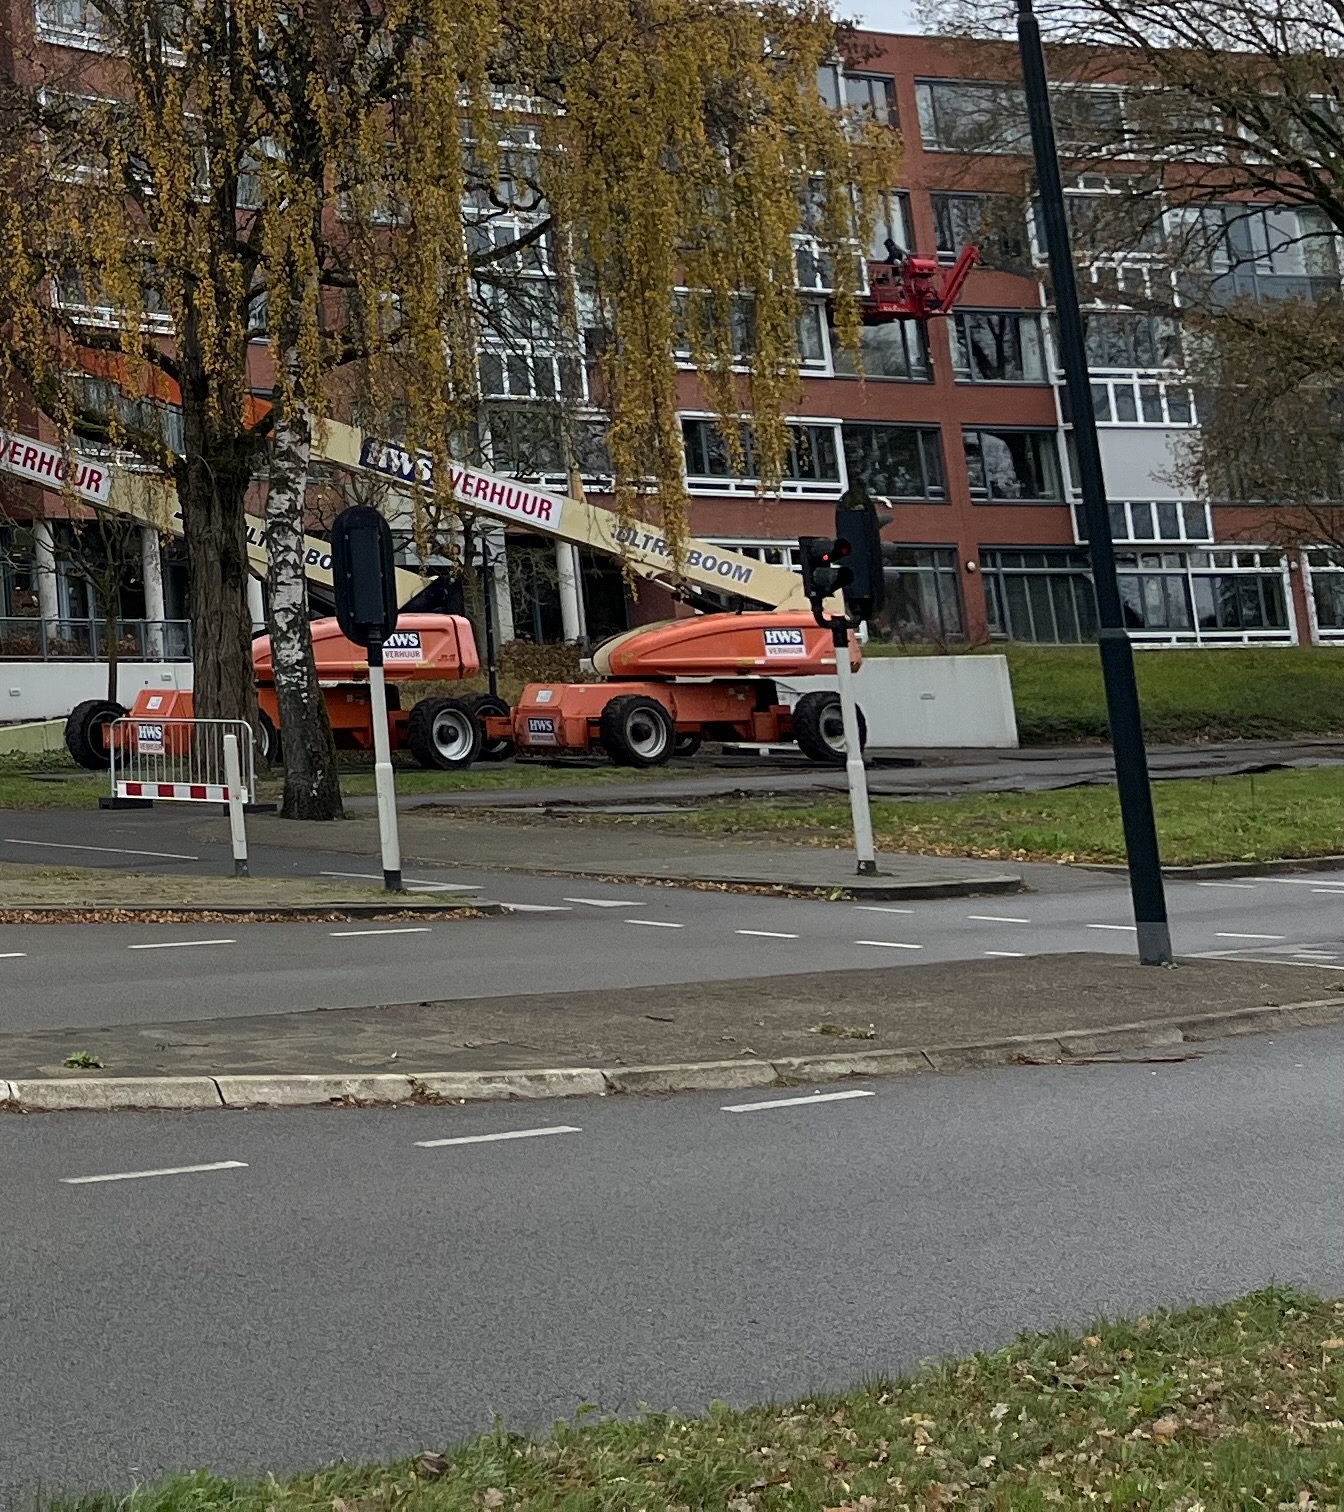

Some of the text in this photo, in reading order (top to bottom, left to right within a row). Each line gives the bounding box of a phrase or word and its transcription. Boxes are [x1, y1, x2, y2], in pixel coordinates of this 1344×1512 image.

[366, 442, 553, 521] HWS VERHUUR
[688, 549, 753, 584] BOOM
[765, 630, 802, 644] HWS
[138, 725, 162, 739] HWS
[529, 719, 553, 732] HWS
